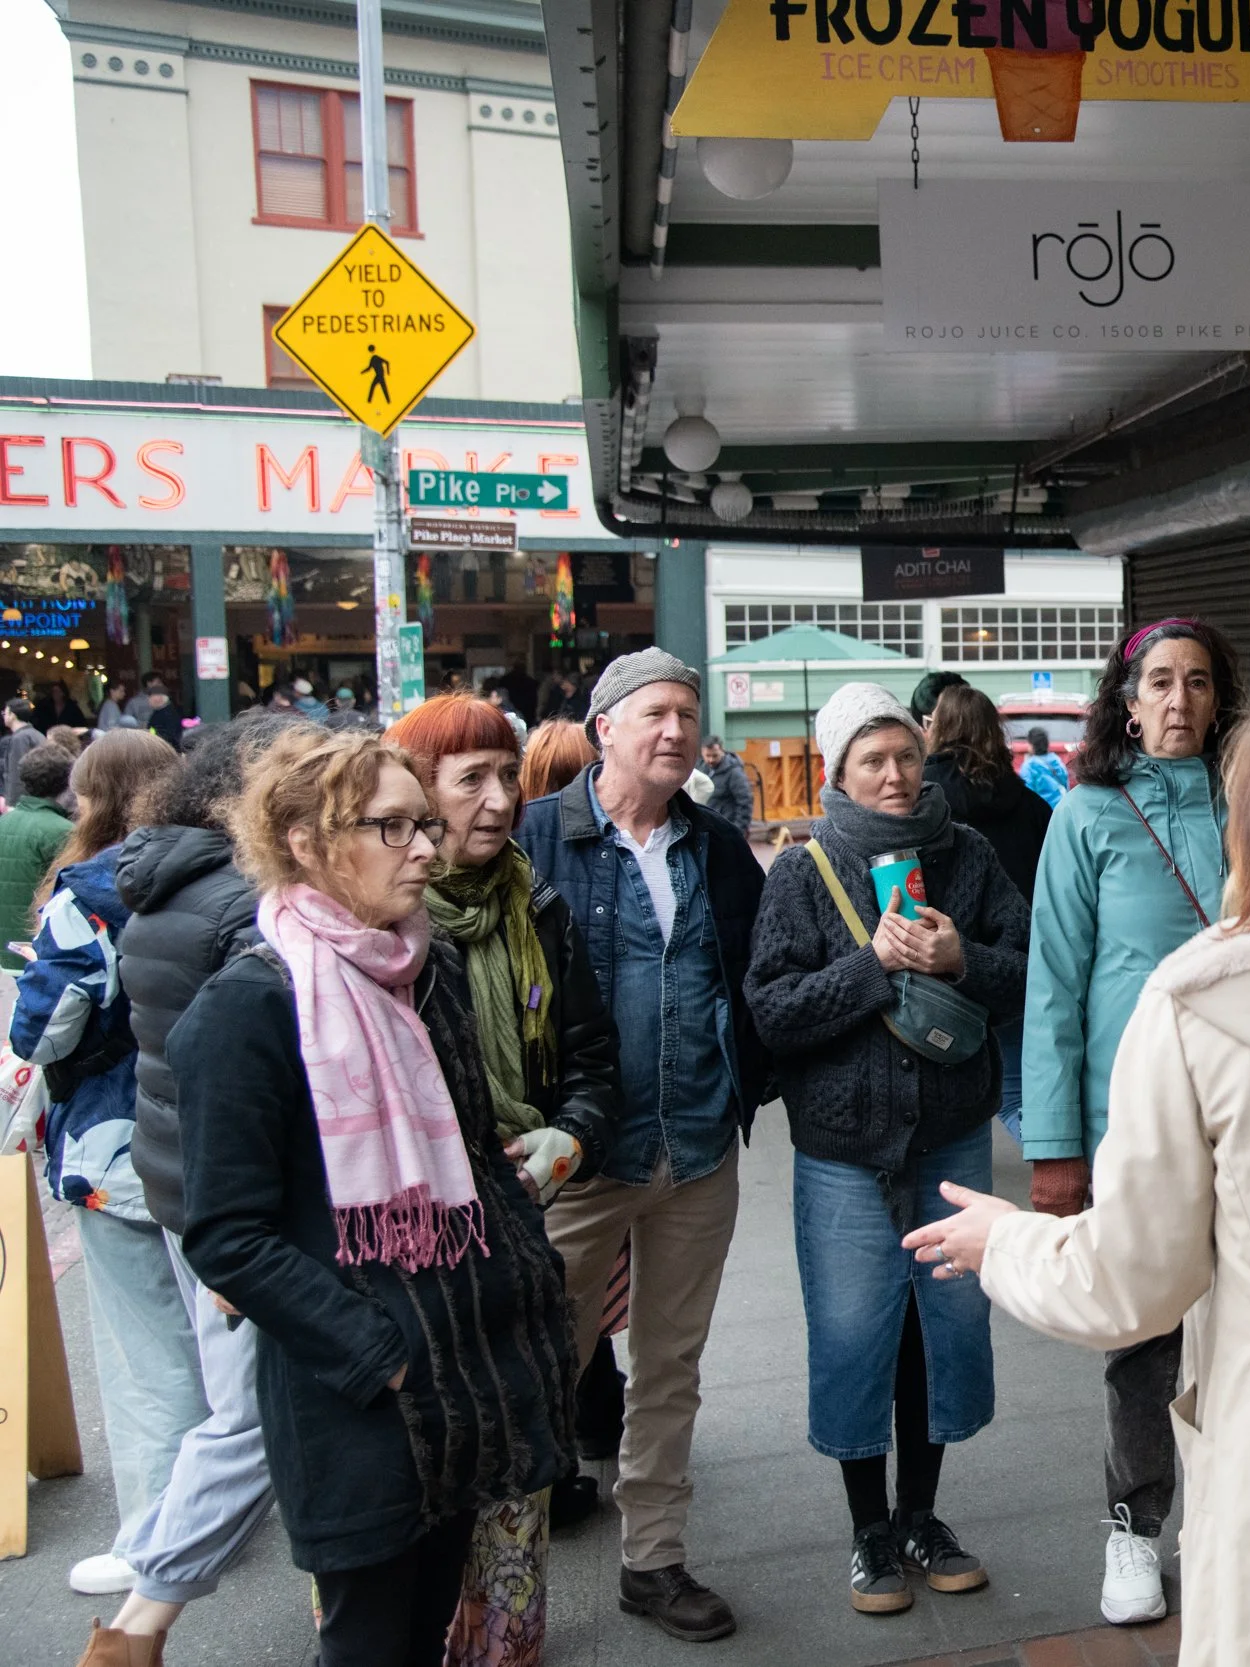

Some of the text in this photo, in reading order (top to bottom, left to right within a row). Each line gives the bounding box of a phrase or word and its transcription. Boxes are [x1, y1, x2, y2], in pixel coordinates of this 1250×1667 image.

[820, 52, 976, 84] ICE CREAM
[1096, 58, 1240, 89] SMOOTHIES
[343, 264, 402, 283] YIELD
[362, 289, 385, 308] TO
[302, 313, 446, 334] PEDESTRIANS
[905, 325, 964, 339] ROJO
[977, 325, 1039, 339] JUICE
[1052, 325, 1089, 339] CO.
[1101, 325, 1164, 338] 1500B
[1176, 325, 1223, 338] PIKE
[0, 435, 187, 511] ERS
[418, 472, 481, 503] Pike
[413, 529, 514, 545] Pike Place Market
[894, 559, 972, 577] ADITI CHAI
